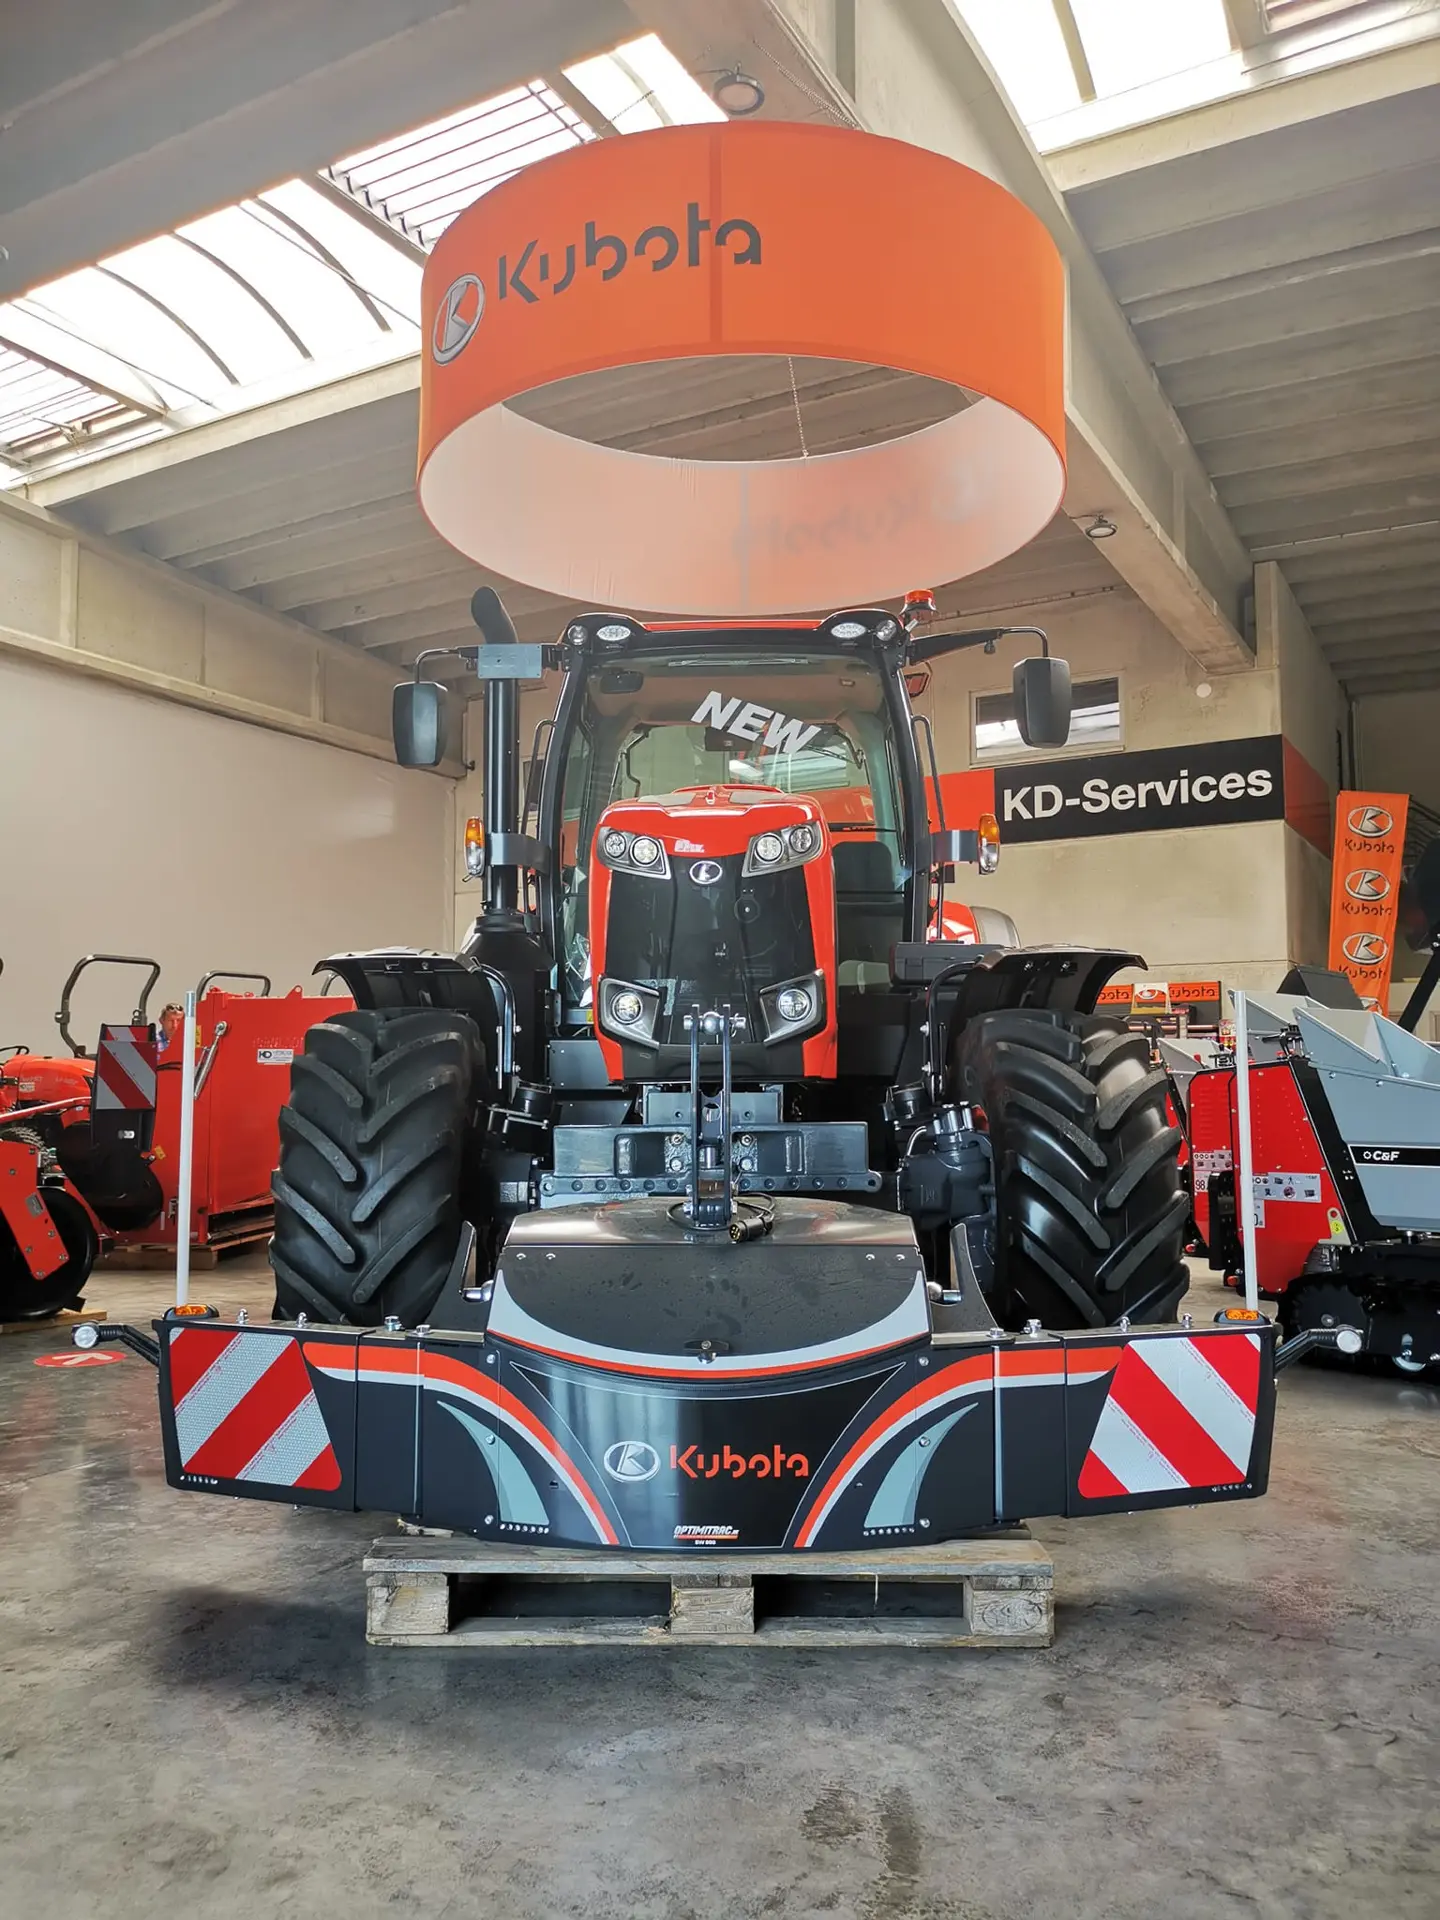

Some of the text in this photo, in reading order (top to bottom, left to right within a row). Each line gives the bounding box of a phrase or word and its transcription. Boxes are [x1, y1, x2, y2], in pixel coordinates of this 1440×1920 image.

[498, 202, 762, 304] Kubota
[690, 690, 822, 755] NEW
[1003, 769, 1273, 822] KD-Services
[1344, 838, 1395, 854] Kubota
[1341, 902, 1393, 916] Kubota
[1100, 989, 1130, 1000] bota
[1372, 1150, 1400, 1161] C&F
[1195, 1179, 1206, 1190] 98
[669, 1444, 809, 1479] Kubota
